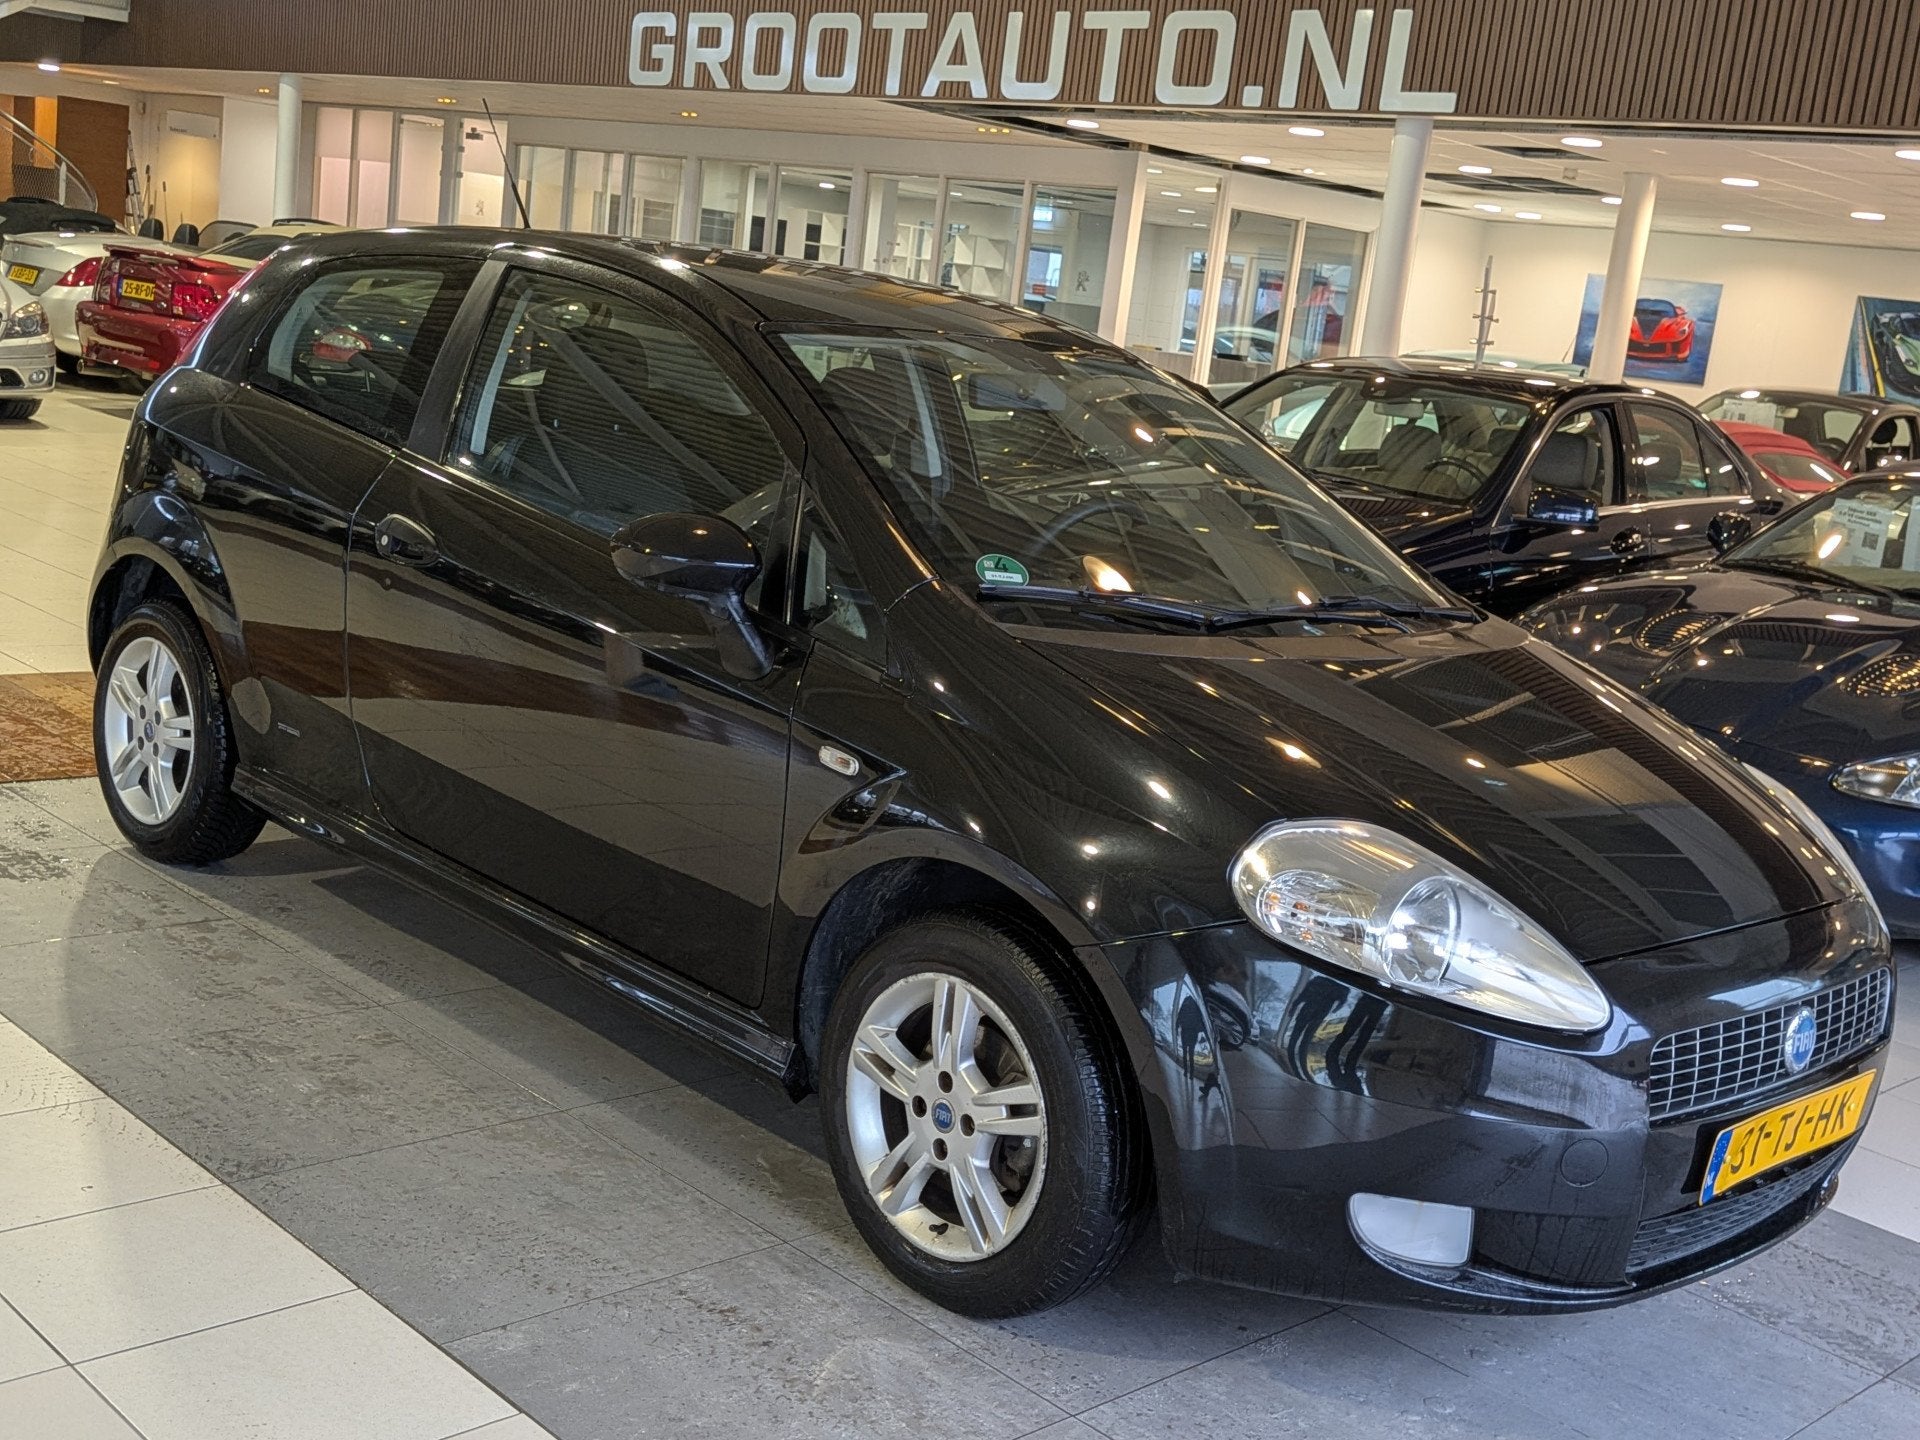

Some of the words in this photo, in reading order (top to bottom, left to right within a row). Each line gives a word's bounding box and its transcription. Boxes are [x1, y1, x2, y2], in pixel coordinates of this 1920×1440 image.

[629, 9, 1457, 113] GROOTAUTO.NL
[994, 557, 1009, 573] 4
[1793, 1030, 1814, 1054] FIAT
[935, 1108, 951, 1124] FIAT
[1730, 1087, 1857, 1174] 31-TJ-HK
